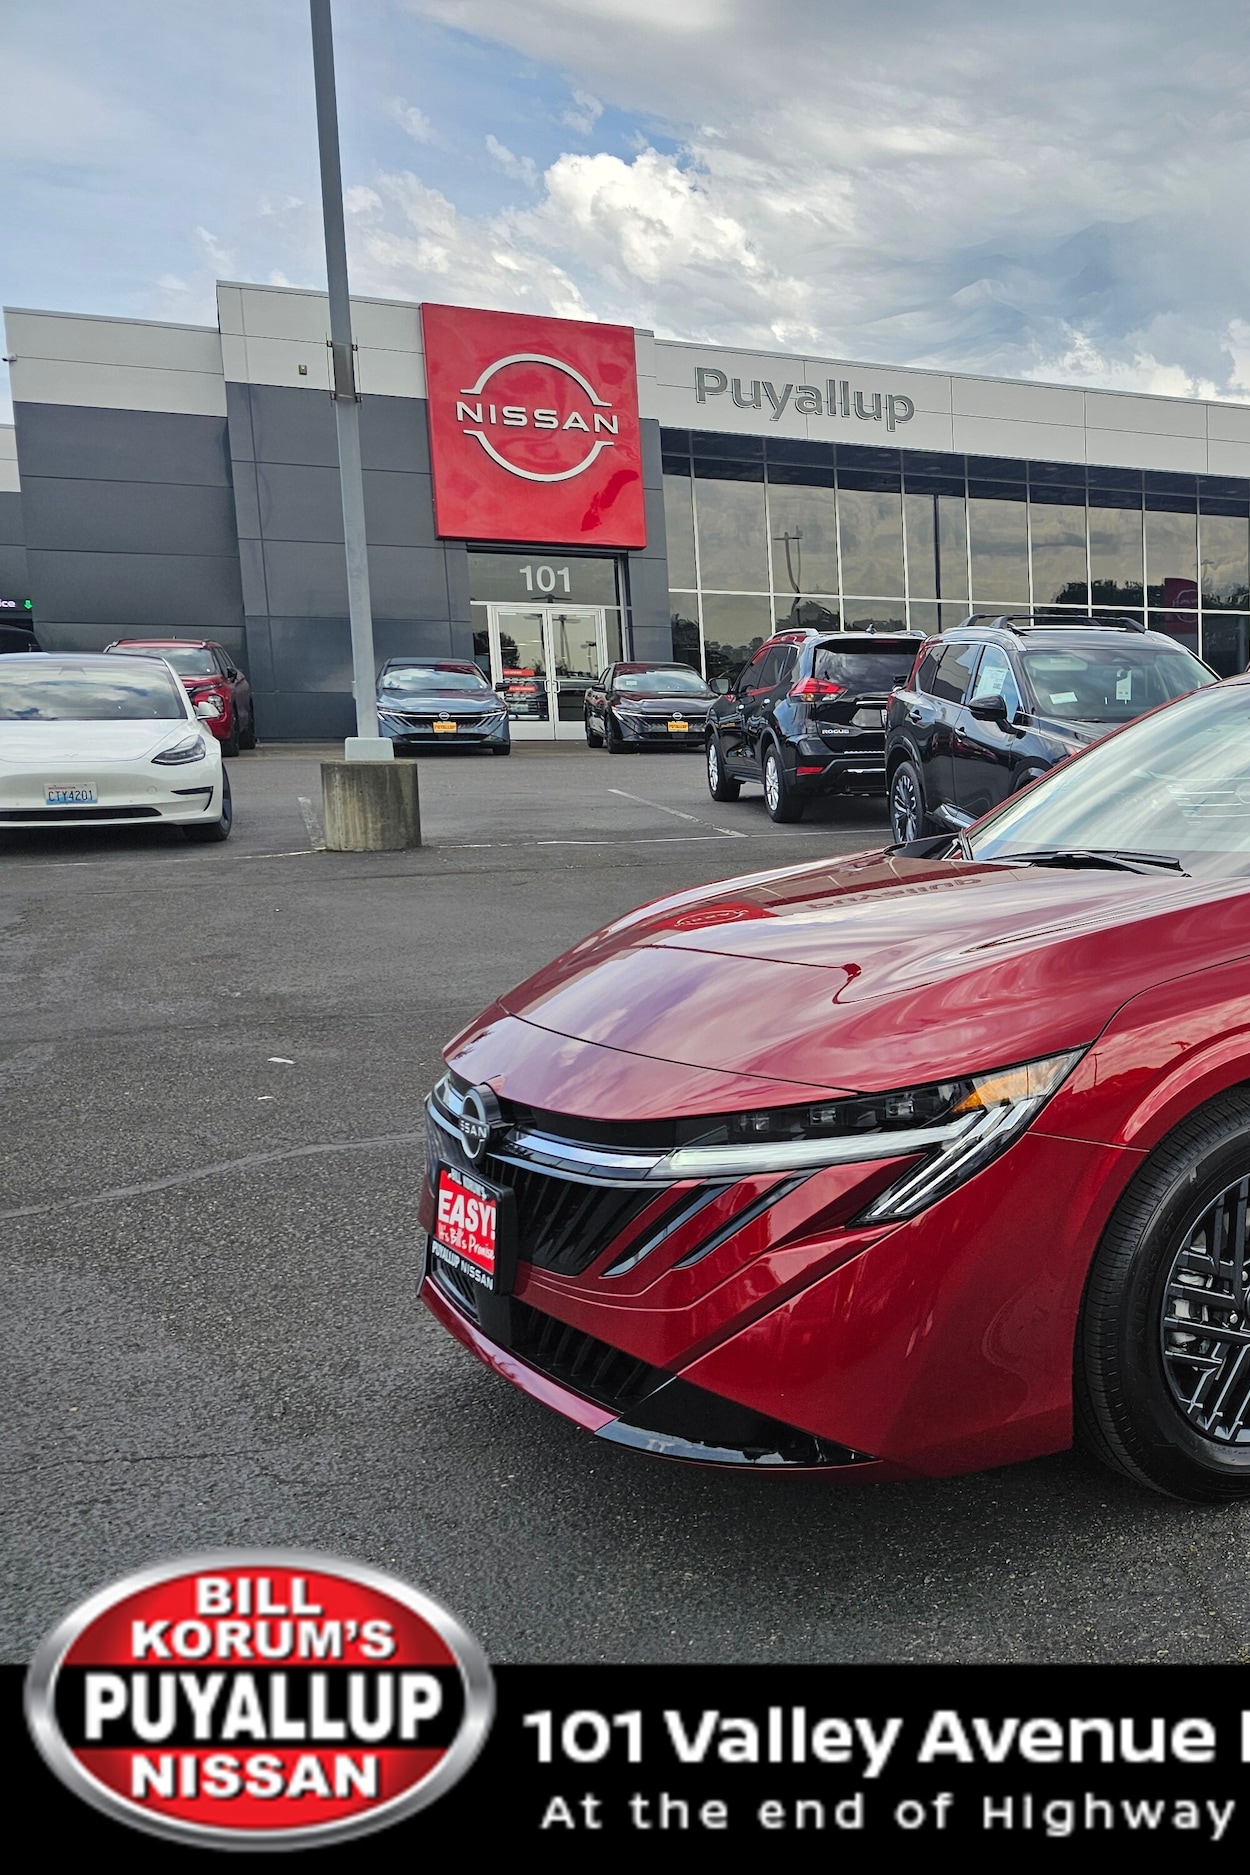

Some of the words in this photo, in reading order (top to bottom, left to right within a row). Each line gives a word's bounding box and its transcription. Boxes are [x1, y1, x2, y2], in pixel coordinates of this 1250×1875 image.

[456, 401, 619, 434] NISSAN
[694, 366, 915, 432] Puyallup
[519, 565, 571, 593] 101
[438, 1189, 497, 1240] EASY!
[432, 1240, 460, 1268] PUYALLUP
[461, 1263, 494, 1290] NISSAN
